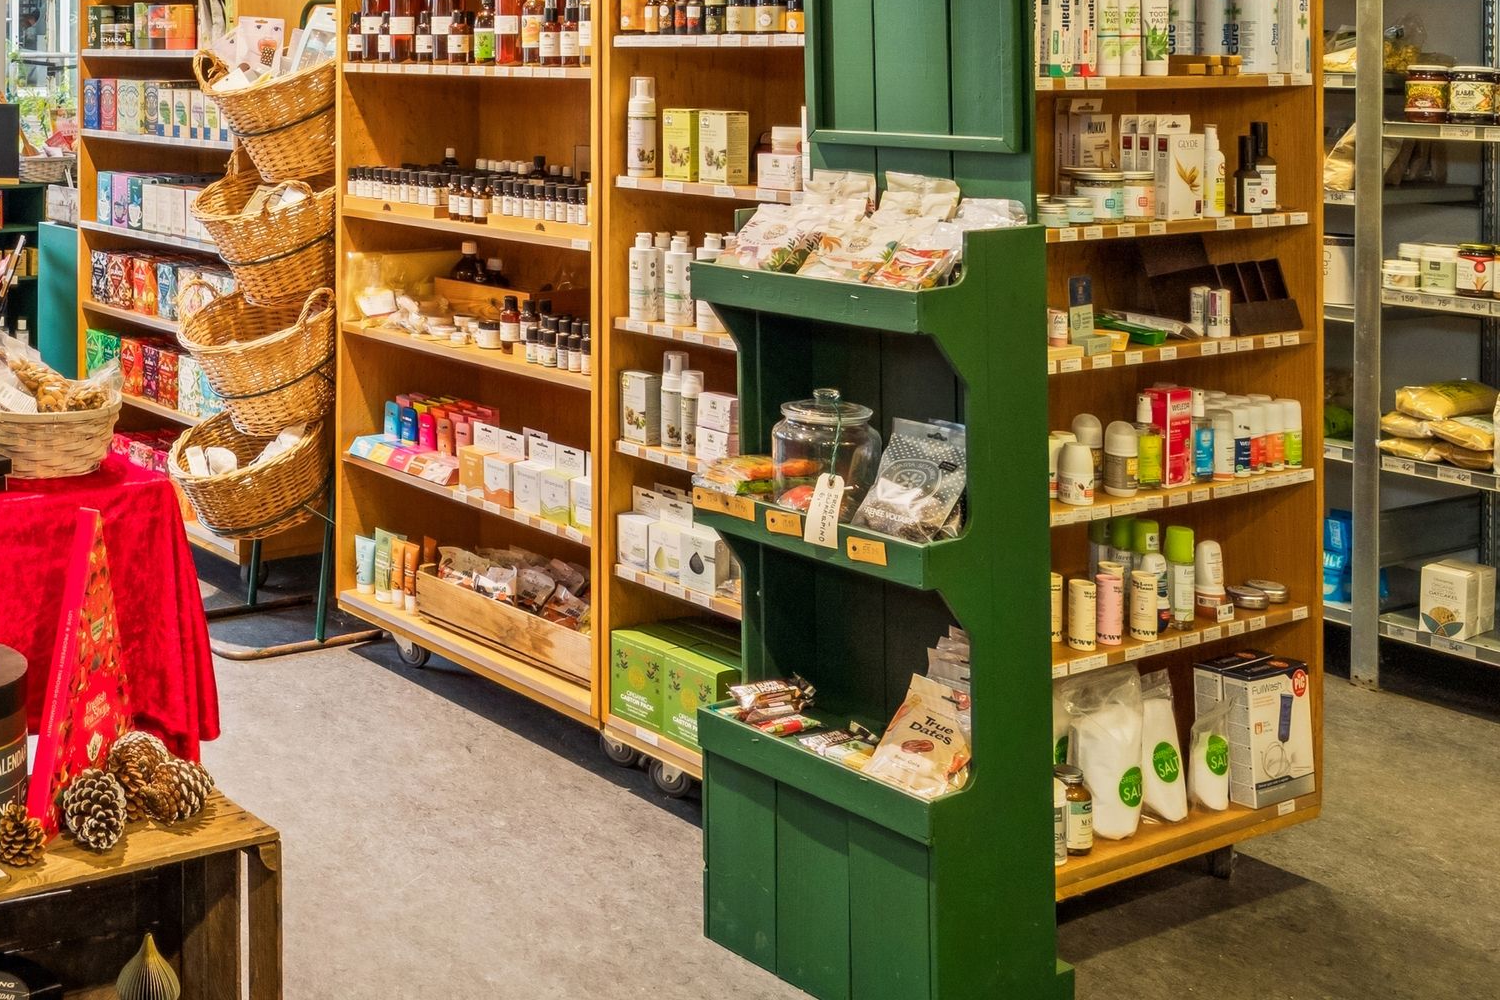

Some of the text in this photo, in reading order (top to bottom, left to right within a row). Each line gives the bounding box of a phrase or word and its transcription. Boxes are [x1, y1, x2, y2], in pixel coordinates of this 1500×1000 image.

[1177, 138, 1199, 149] GLYDE
[1170, 402, 1191, 412] WELEDA
[54, 669, 63, 699] THROUGH
[1251, 680, 1282, 695] FullWash
[47, 699, 58, 738] COMMUNITY
[924, 715, 954, 735] True
[909, 721, 953, 745] Dates
[1157, 756, 1180, 778] SALT
